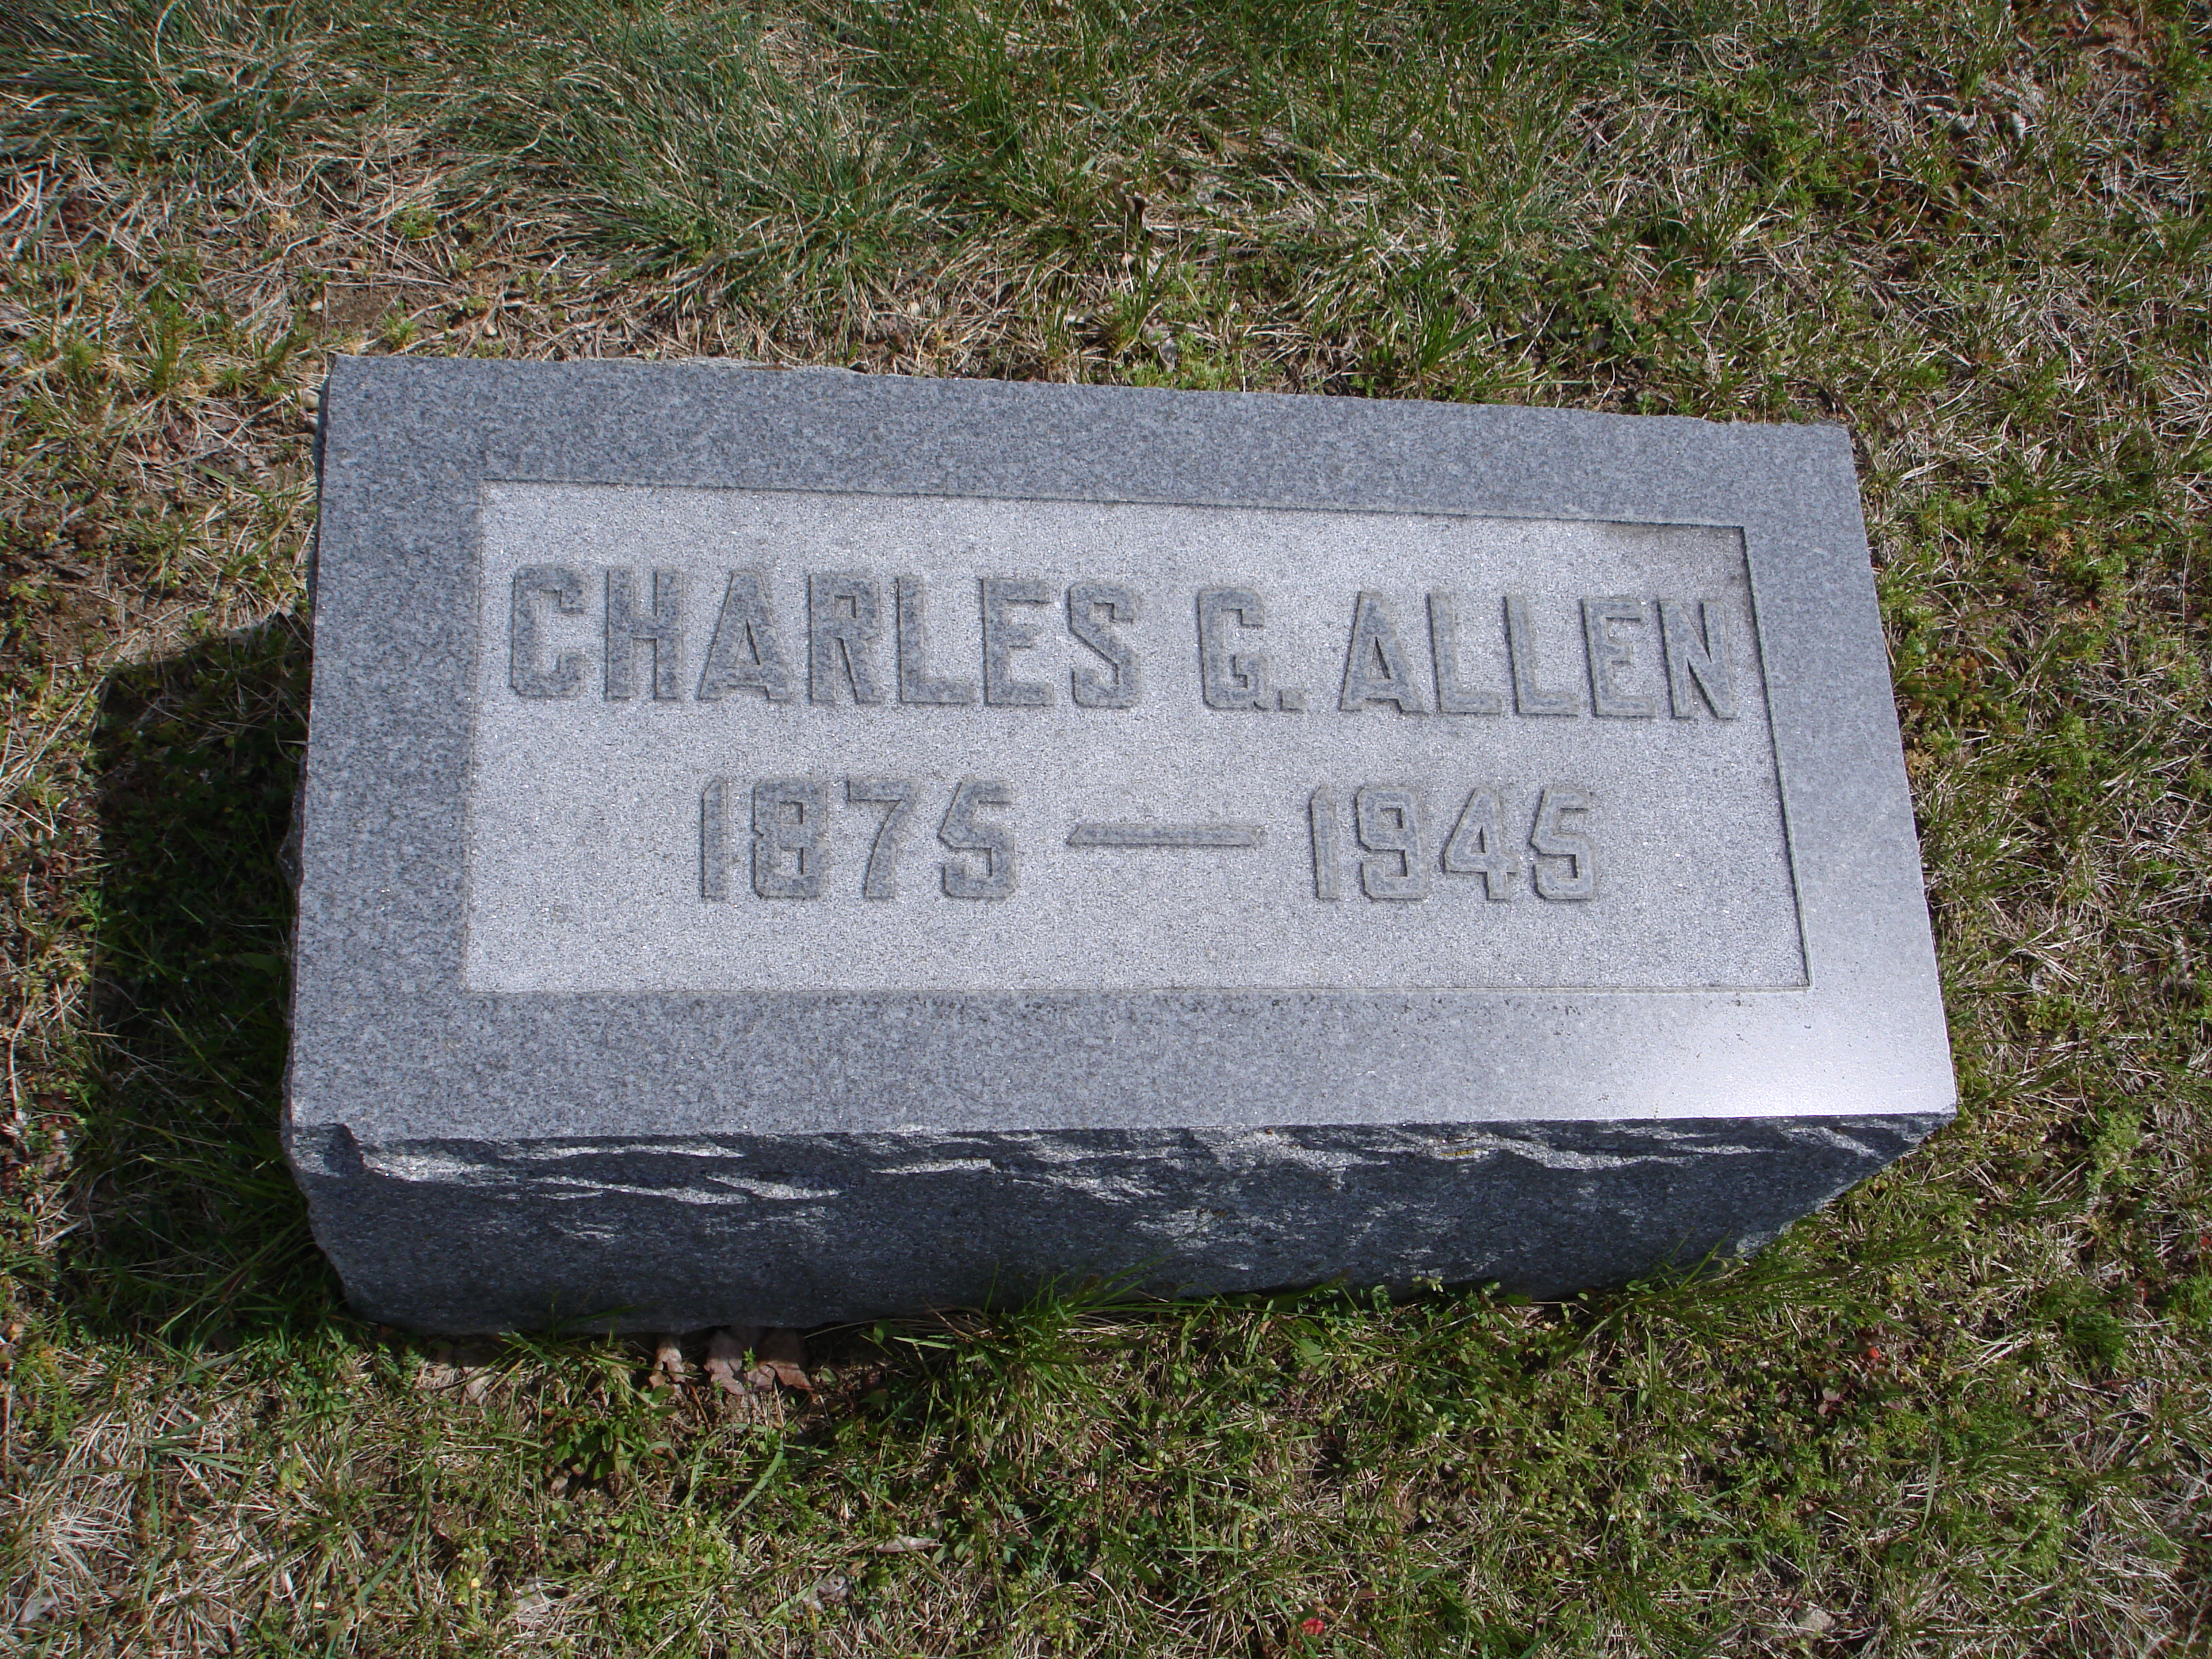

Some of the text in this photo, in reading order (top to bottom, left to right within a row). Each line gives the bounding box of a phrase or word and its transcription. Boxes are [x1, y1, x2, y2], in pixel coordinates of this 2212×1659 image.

[508, 563, 1739, 720] CHARLES G. ALLEN
[699, 774, 1017, 900] 1875
[1309, 784, 1598, 901] 1945
